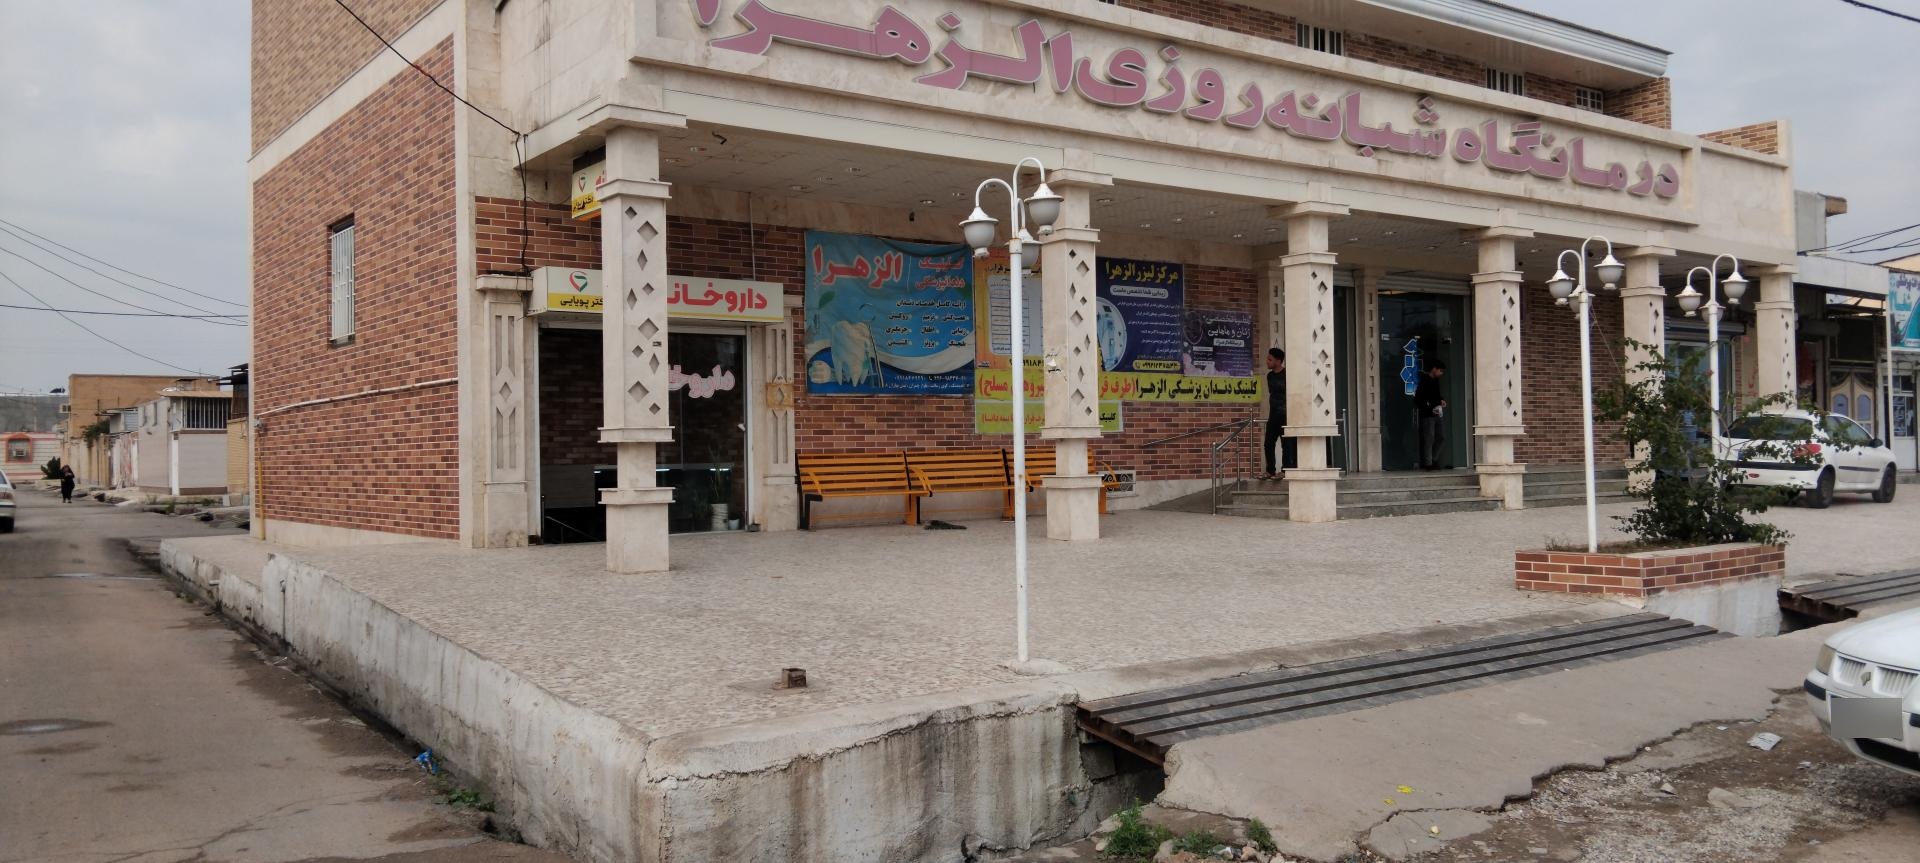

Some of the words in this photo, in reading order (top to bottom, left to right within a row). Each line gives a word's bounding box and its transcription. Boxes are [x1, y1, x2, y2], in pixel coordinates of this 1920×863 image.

[1451, 119, 1681, 198] درمانگاه
[811, 243, 903, 289] الزهرا
[1105, 260, 1136, 281] الزهرا
[1135, 263, 1155, 283] لیزر
[1154, 264, 1179, 285] مرکز
[560, 296, 593, 309] پویایی
[590, 297, 604, 308] کتر
[667, 281, 768, 313] داروخان
